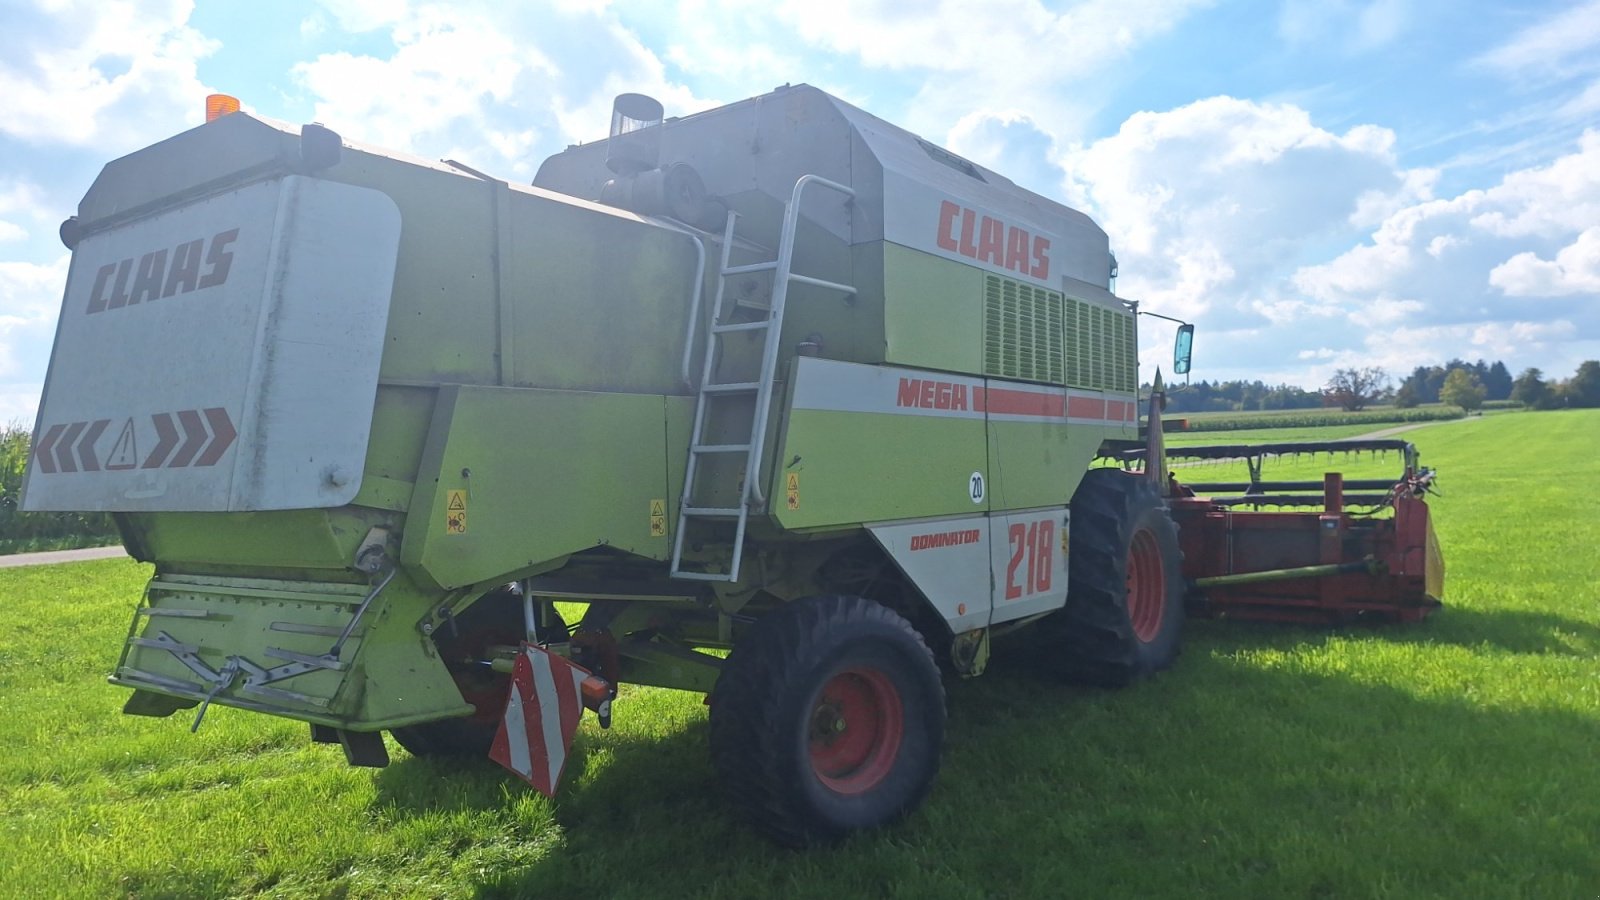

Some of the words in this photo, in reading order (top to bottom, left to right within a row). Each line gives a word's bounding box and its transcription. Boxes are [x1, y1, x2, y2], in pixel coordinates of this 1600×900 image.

[937, 200, 1050, 280] CLAAS
[86, 228, 239, 314] CLAAS
[897, 378, 967, 411] MEGA
[971, 476, 983, 499] 20
[910, 529, 980, 551] DOMINATOR
[1005, 519, 1054, 600] 218
